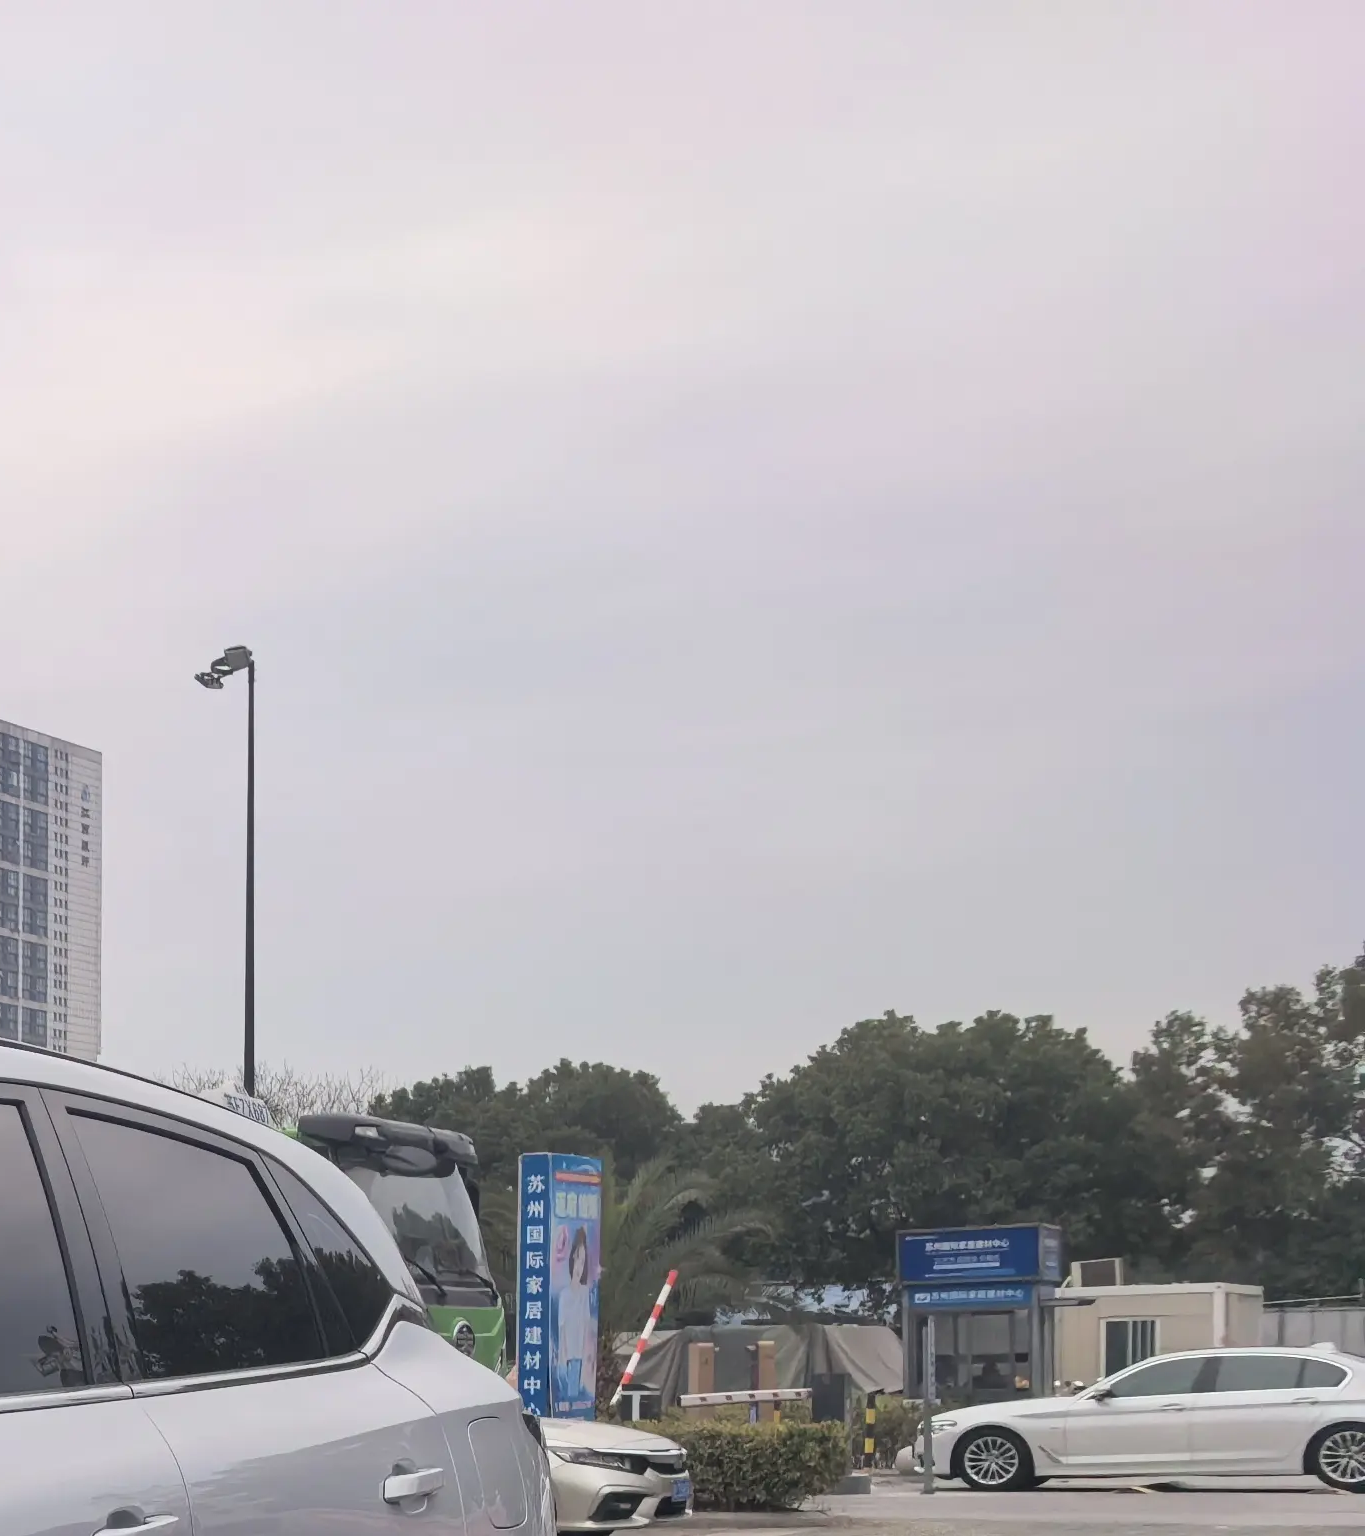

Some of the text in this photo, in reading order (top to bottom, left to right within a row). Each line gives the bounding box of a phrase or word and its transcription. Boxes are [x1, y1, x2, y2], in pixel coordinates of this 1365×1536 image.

[523, 1174, 545, 1417] 苏州国际家居建材中心
